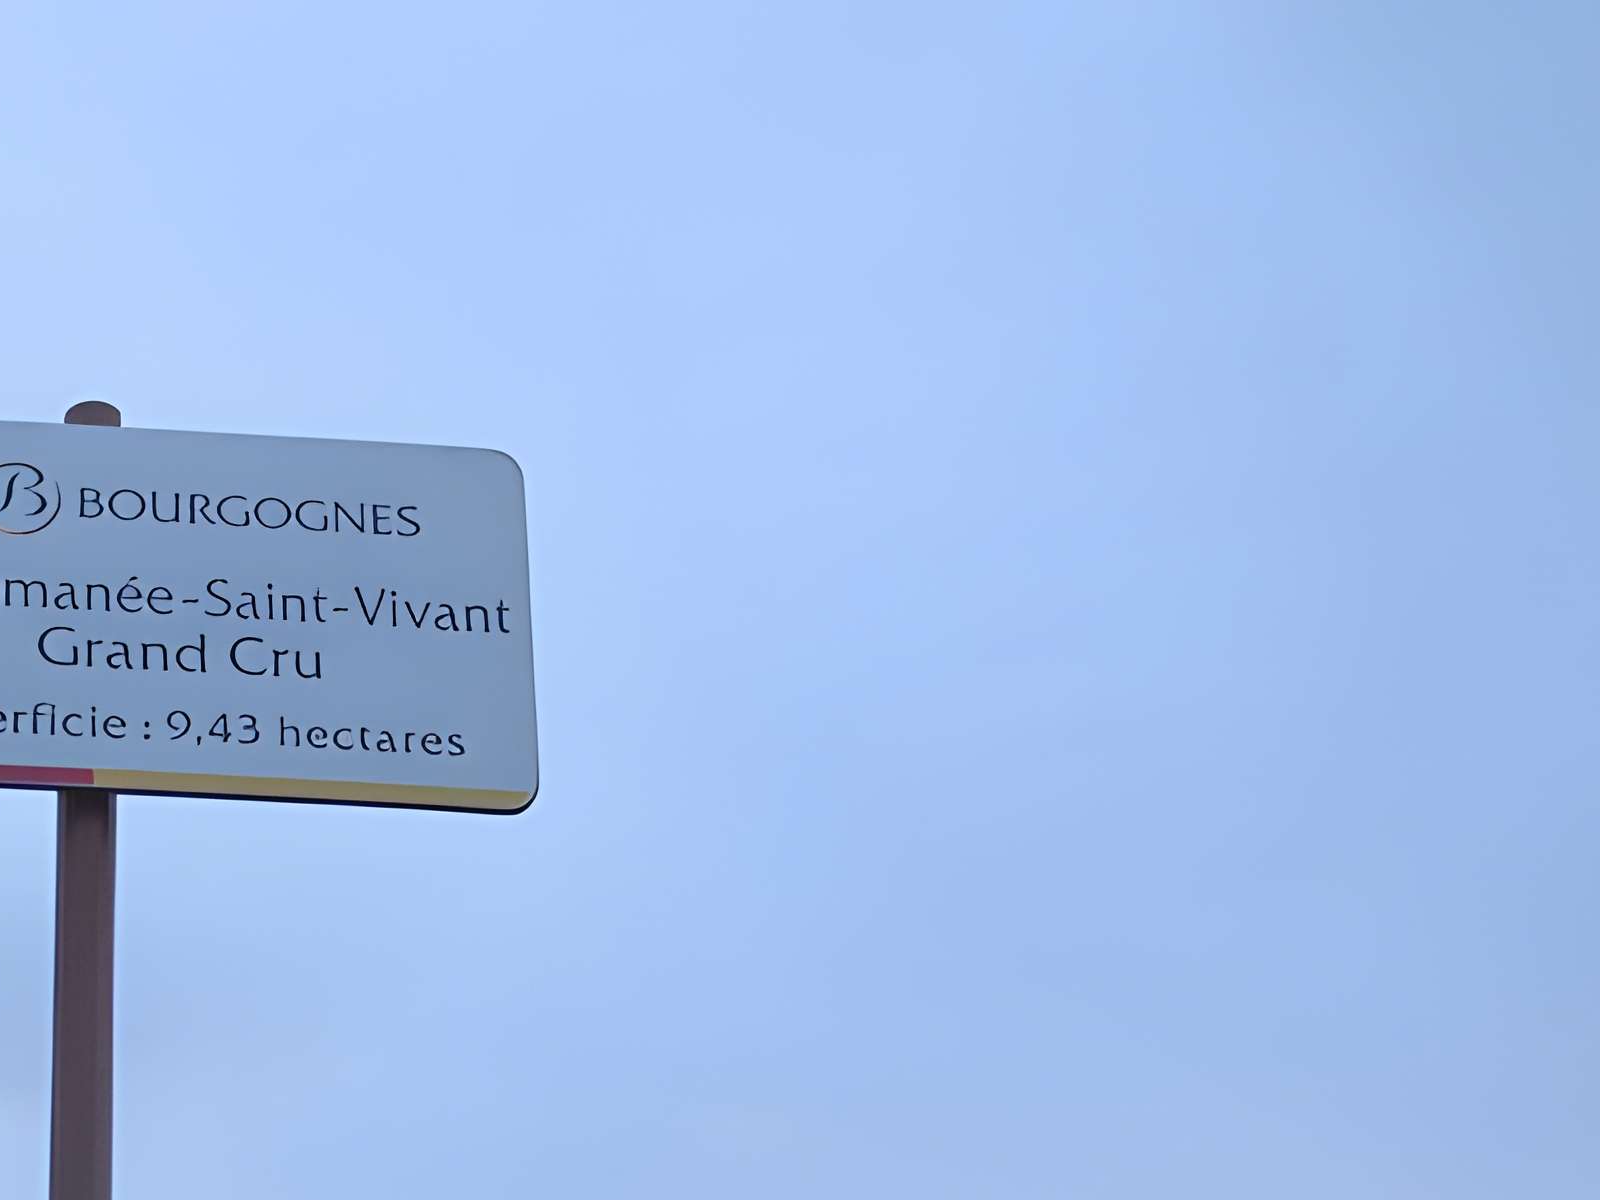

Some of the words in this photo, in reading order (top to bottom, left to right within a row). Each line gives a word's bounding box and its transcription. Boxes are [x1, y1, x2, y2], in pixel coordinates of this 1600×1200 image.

[78, 487, 421, 537] BOURGOGNES
[37, 626, 207, 674] Grand
[229, 636, 323, 680] Cru
[166, 710, 260, 747] 9,43
[279, 715, 466, 757] hectares
